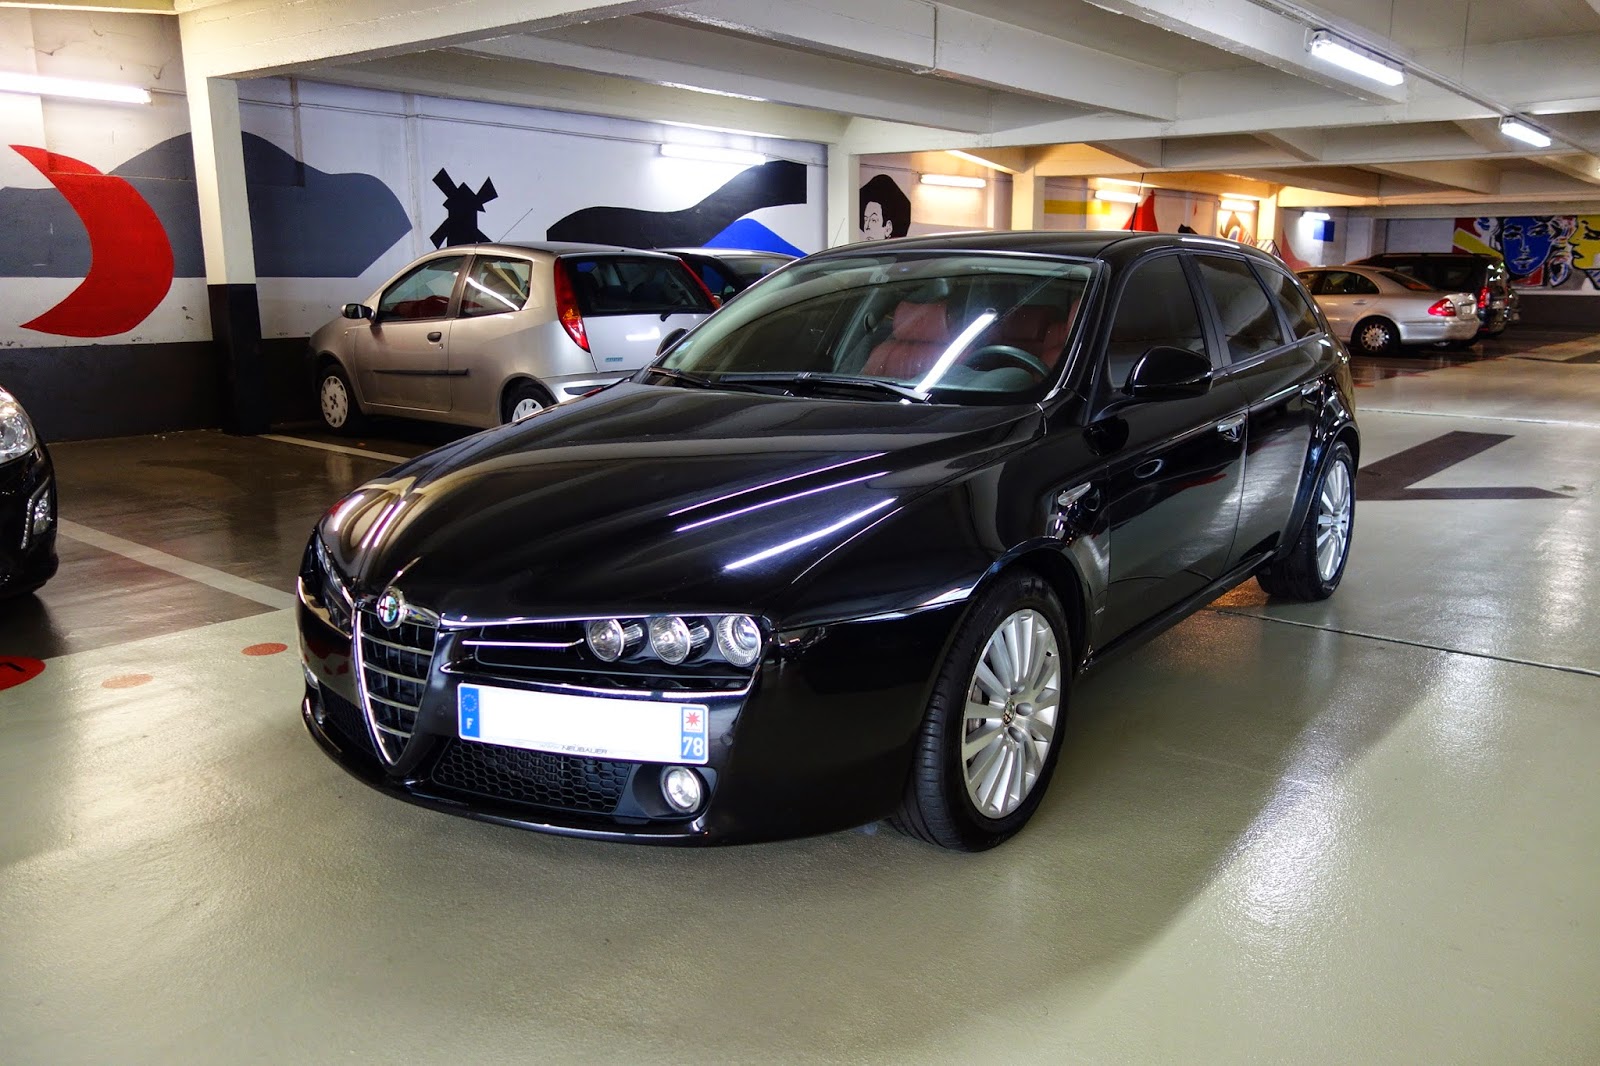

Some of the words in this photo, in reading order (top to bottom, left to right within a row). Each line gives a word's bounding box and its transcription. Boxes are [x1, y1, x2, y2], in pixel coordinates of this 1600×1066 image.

[466, 717, 474, 730] F
[561, 744, 608, 755] NEUBAUER
[682, 735, 704, 757] 78
